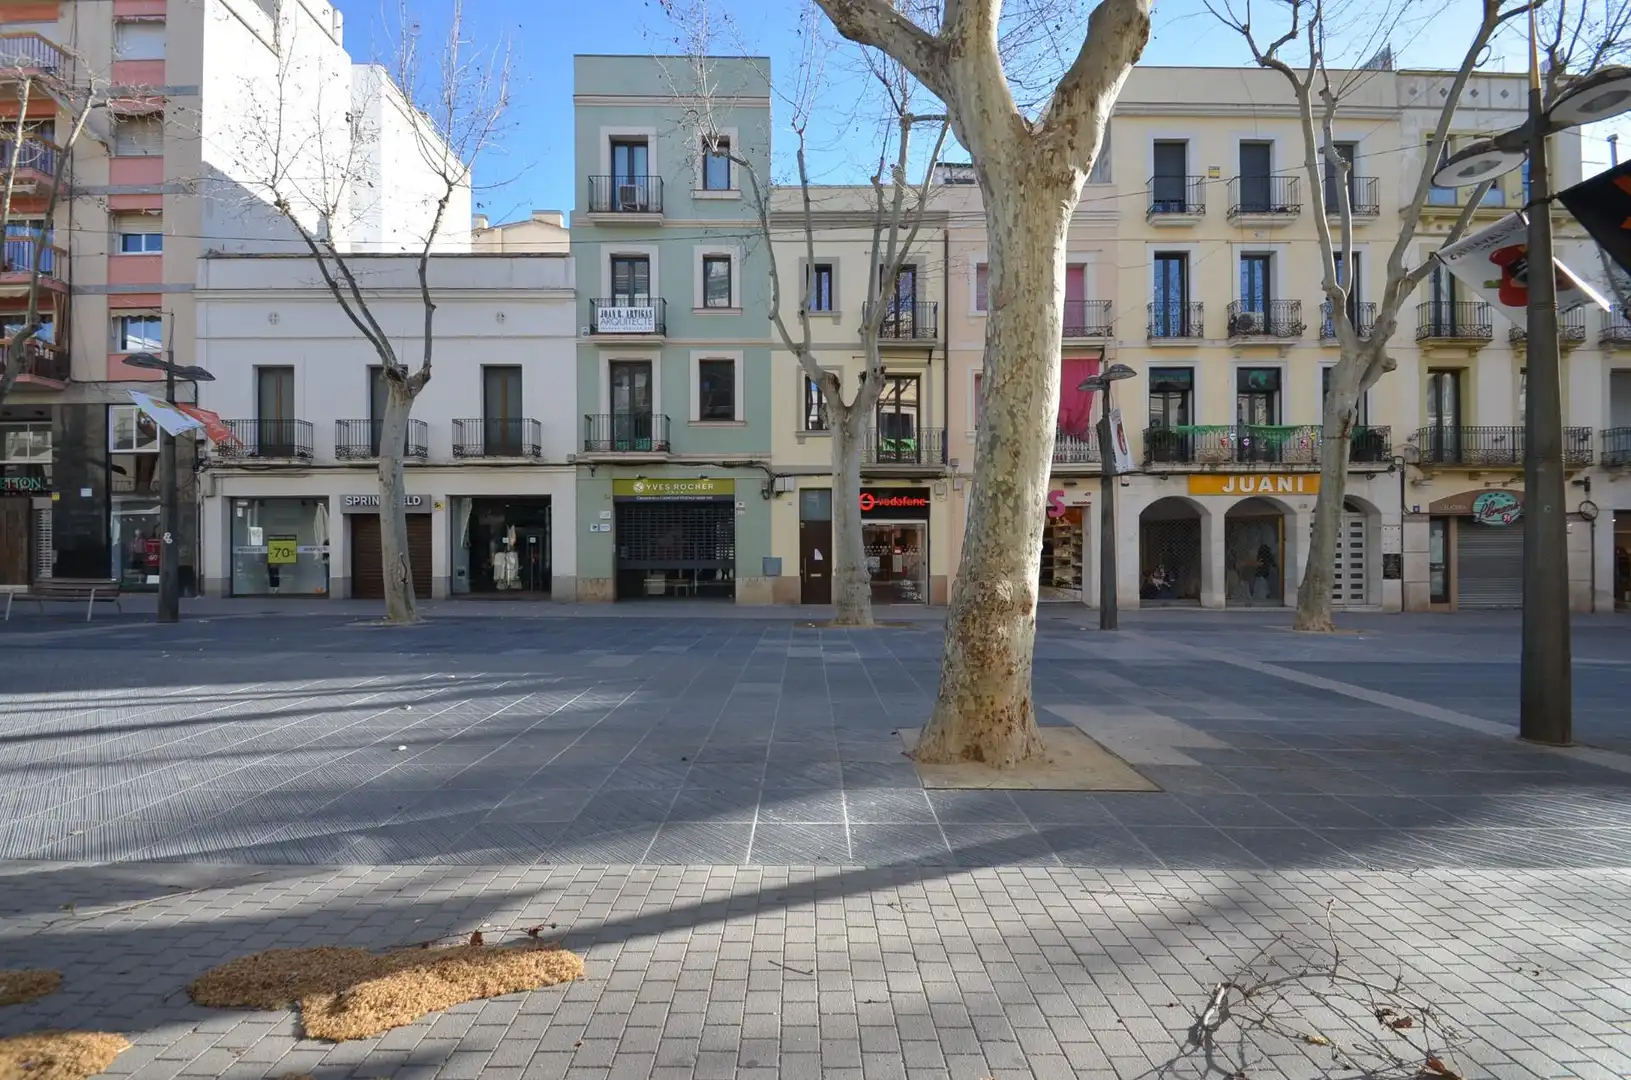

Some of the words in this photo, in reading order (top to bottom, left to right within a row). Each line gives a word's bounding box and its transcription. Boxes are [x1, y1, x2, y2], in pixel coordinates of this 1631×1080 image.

[600, 317, 653, 326] ARQUITECTE
[646, 483, 670, 491] YVES
[673, 483, 714, 491] ROCHER
[1222, 476, 1304, 493] JUANI
[345, 496, 421, 506] SPRINELD
[877, 495, 926, 507] vodafone
